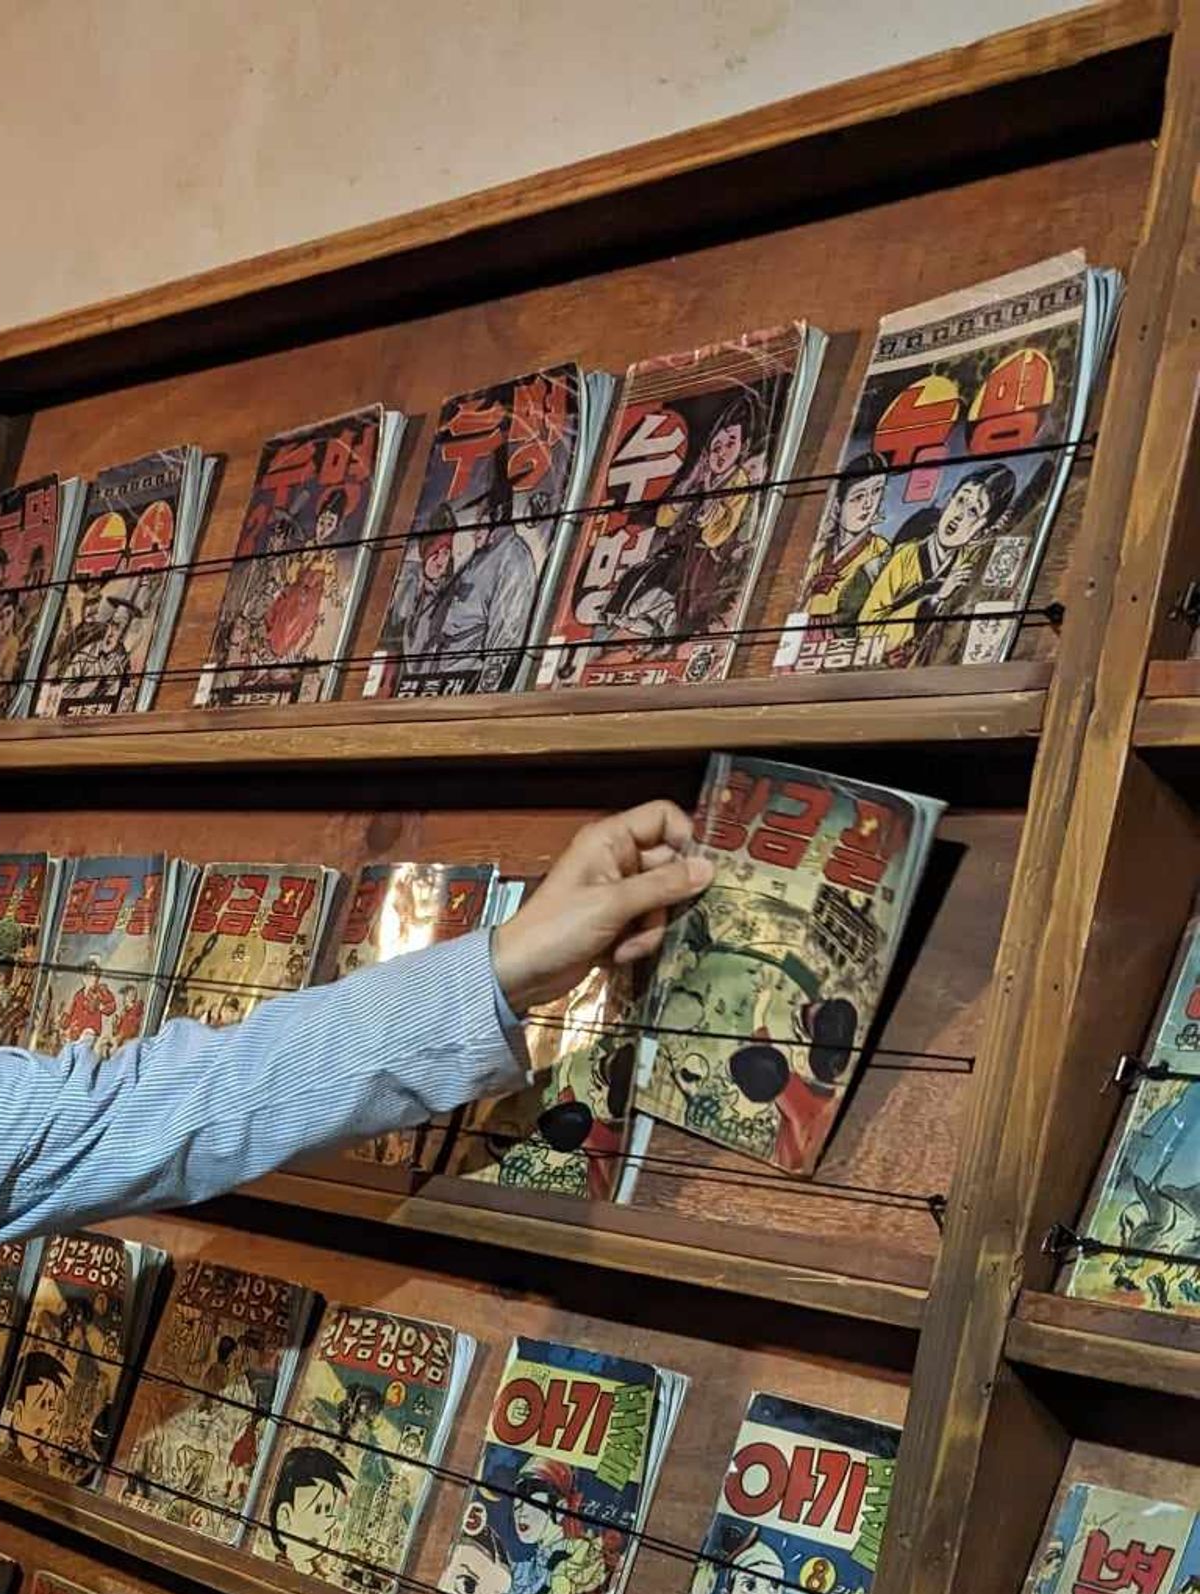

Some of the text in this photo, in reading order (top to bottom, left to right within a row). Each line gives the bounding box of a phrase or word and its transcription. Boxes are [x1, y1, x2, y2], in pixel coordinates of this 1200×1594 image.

[798, 634, 888, 670] 김종래
[493, 1376, 613, 1457] 아기
[724, 1442, 867, 1534] 아기
[466, 1506, 484, 1531] 5
